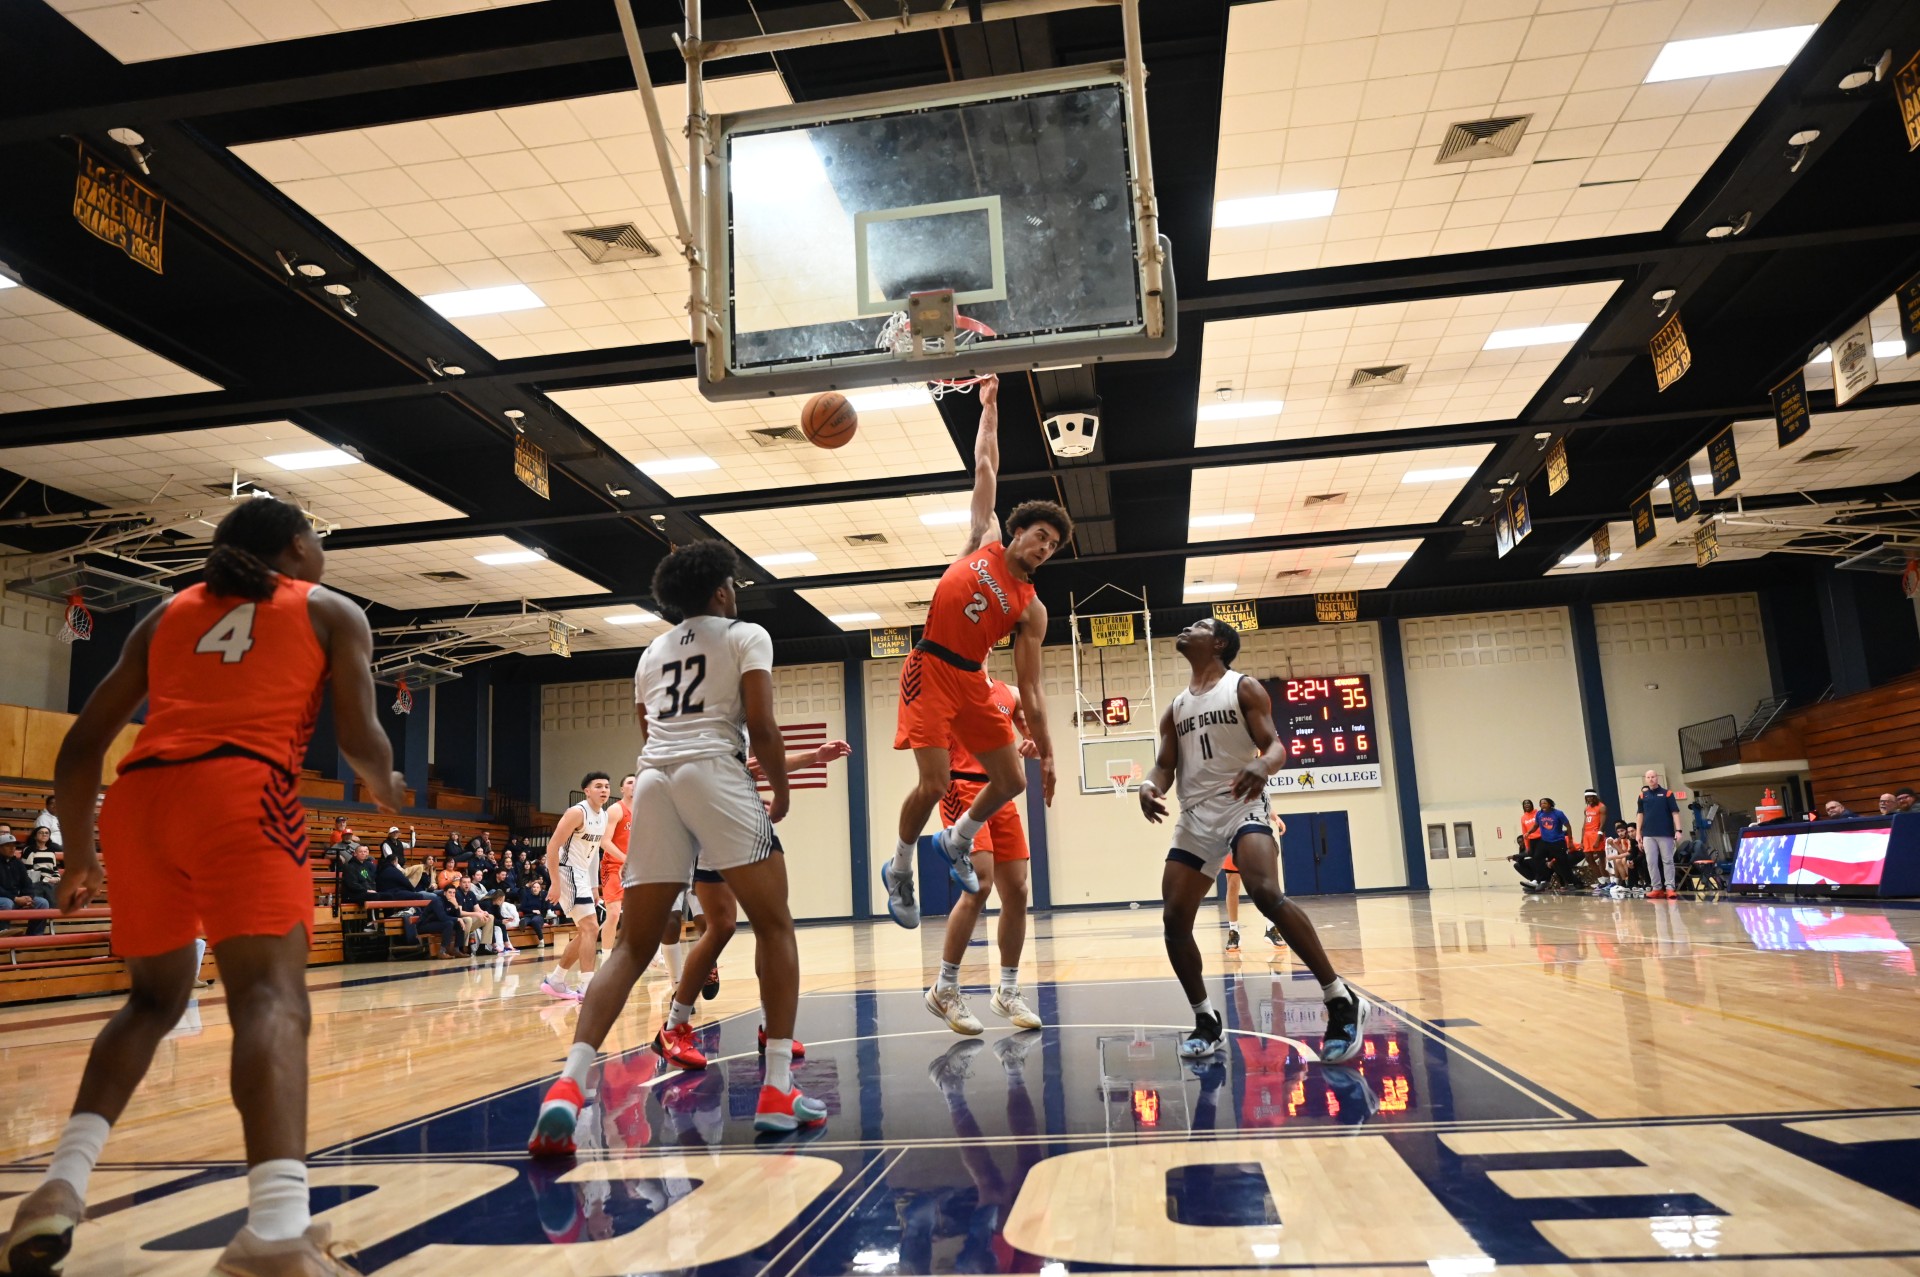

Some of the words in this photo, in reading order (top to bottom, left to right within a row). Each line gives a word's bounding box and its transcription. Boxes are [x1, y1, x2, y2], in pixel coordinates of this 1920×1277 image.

[80, 175, 157, 244] BASKETBALL
[76, 198, 128, 247] CHAMPS
[131, 234, 160, 267] 1969
[963, 591, 989, 625] 2
[1317, 602, 1356, 611] BASKETBALL
[1094, 616, 1129, 626] CALIFORNIA
[1215, 612, 1256, 623] BASKETBALL
[1317, 611, 1341, 620] CHAMPS
[194, 601, 256, 664] 4
[873, 634, 909, 643] BASKETBALL
[1096, 630, 1129, 639] CHAMPIONS
[877, 641, 905, 649] CHAMPS
[657, 653, 707, 720] 32
[1287, 679, 1329, 702] 2:24
[1341, 687, 1367, 709] 35
[1106, 706, 1128, 723] 24
[1198, 709, 1239, 728] DEVILS
[1295, 714, 1313, 722] period
[1295, 727, 1315, 736] player
[1351, 724, 1366, 732] fouls
[1199, 732, 1214, 760] 11
[1312, 737, 1323, 753] 5
[1334, 736, 1345, 752] 6
[1356, 734, 1368, 751] 6
[1321, 771, 1377, 783] COLLEGE
